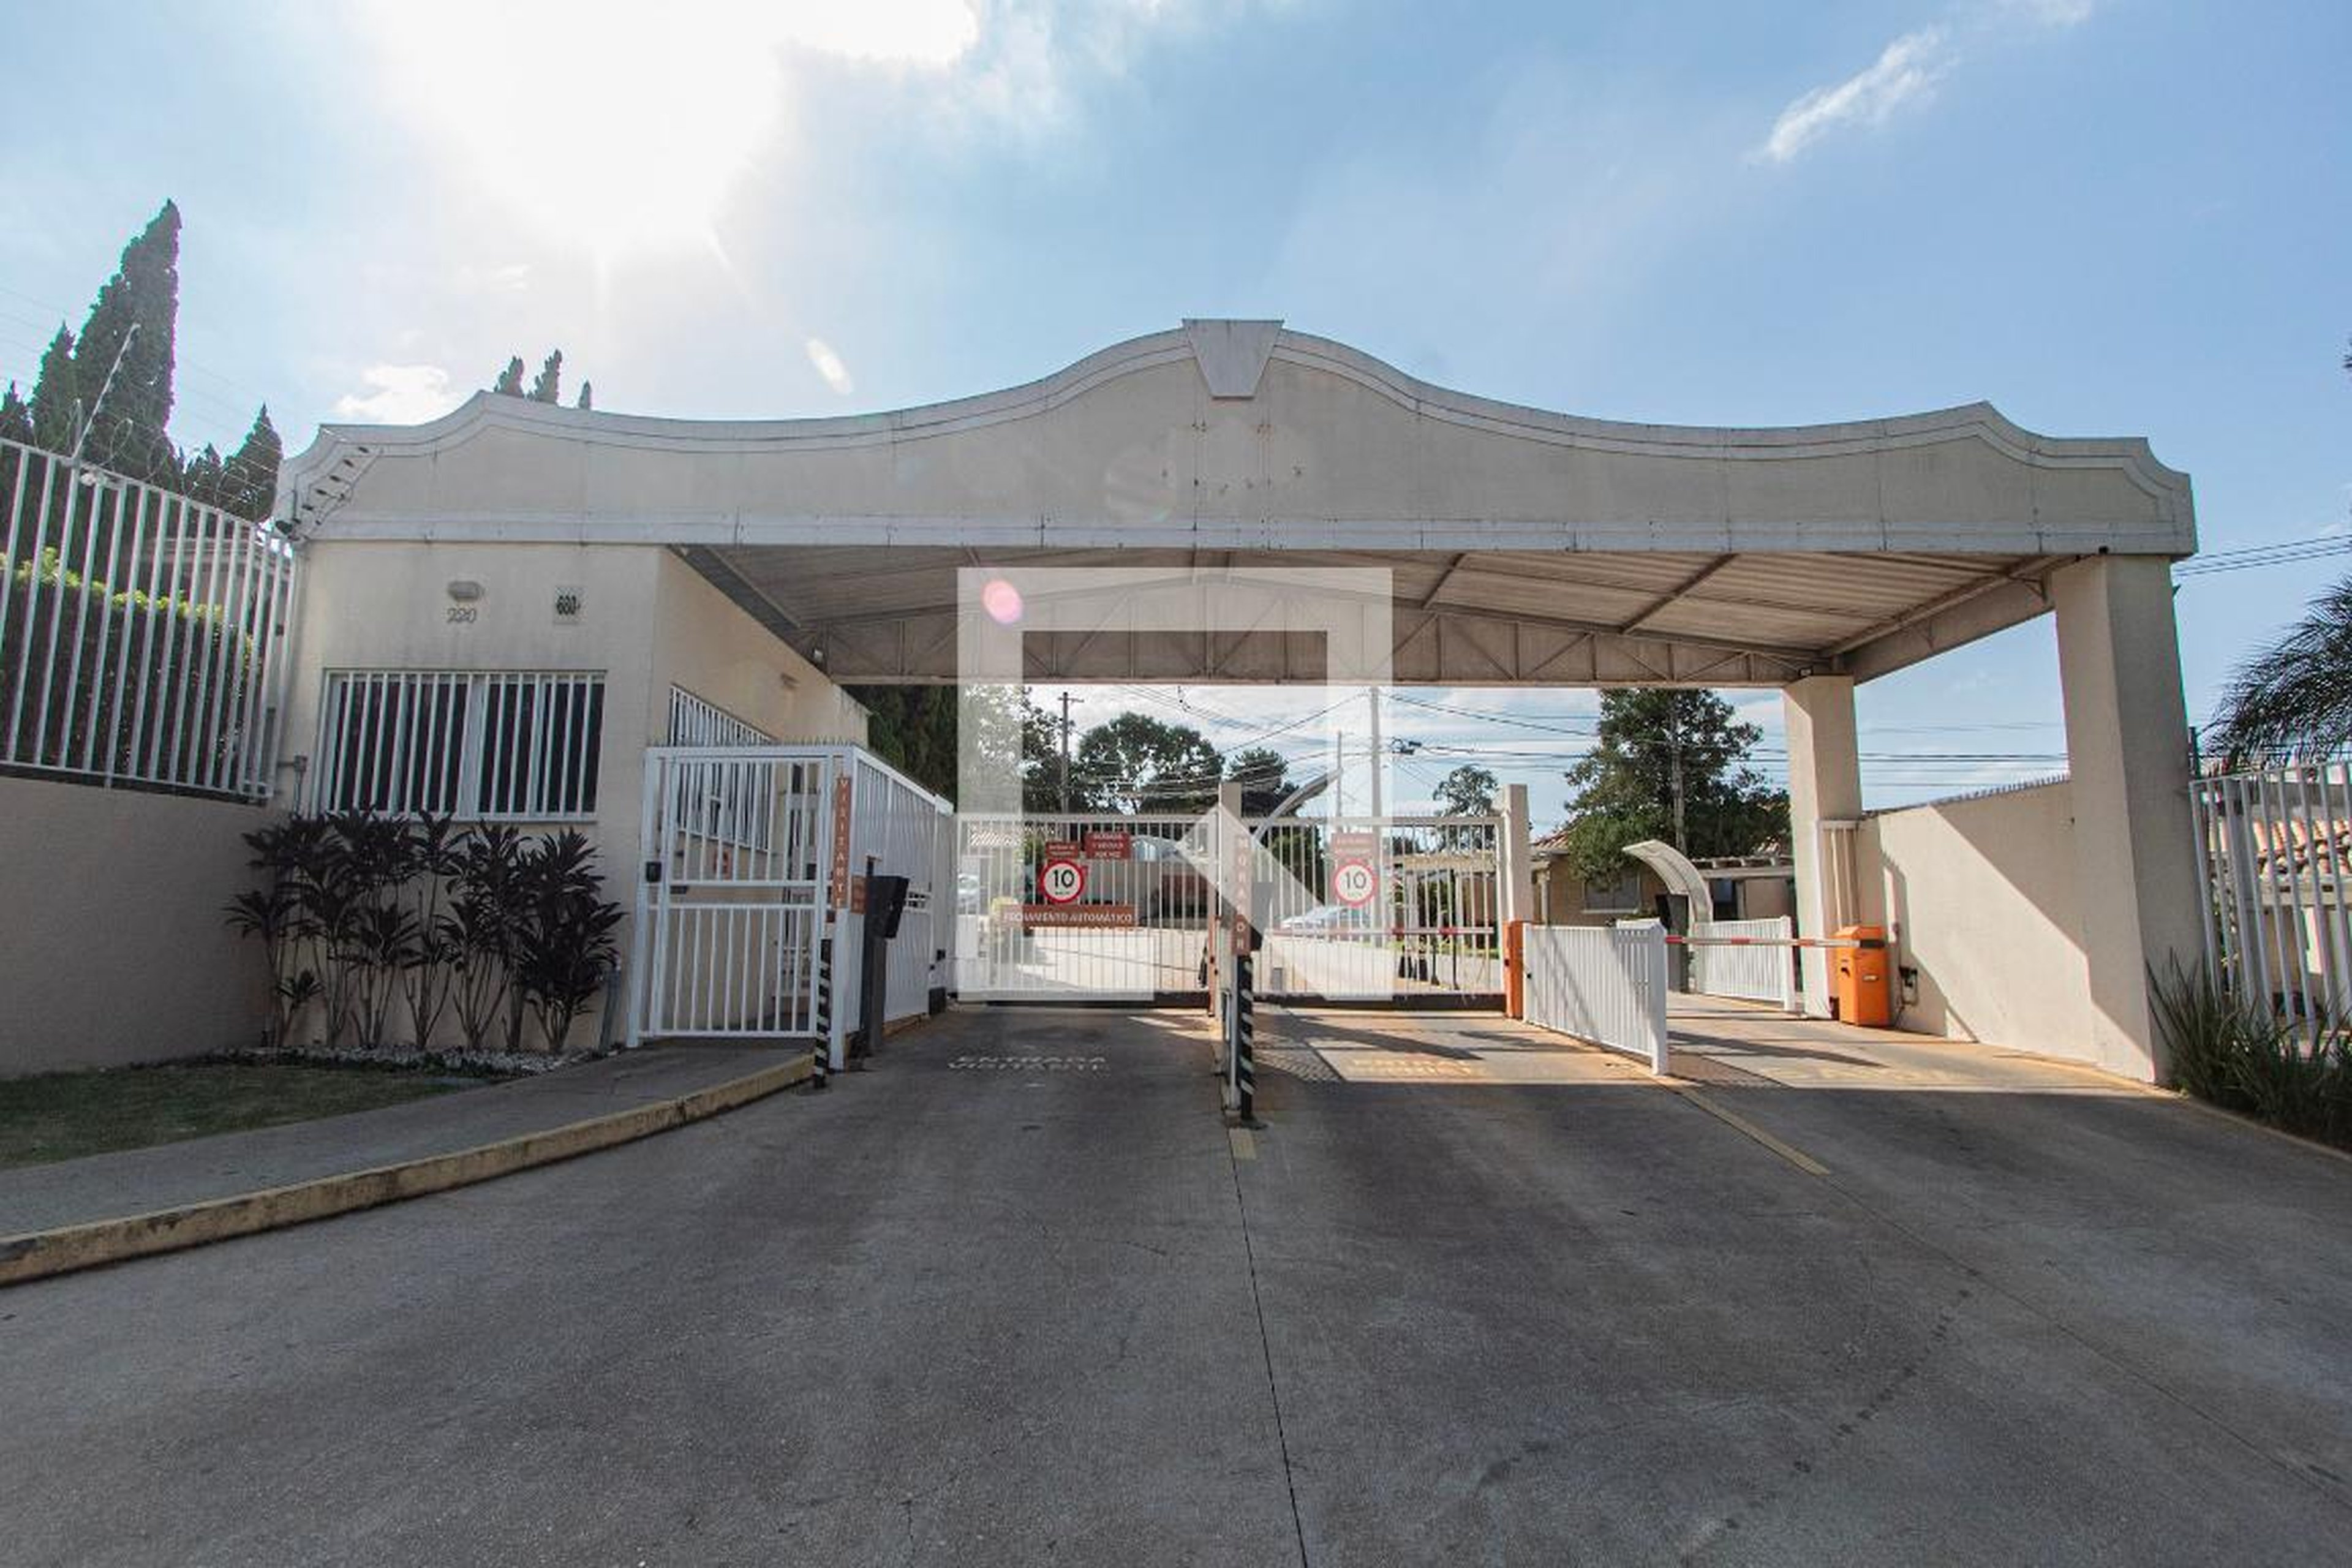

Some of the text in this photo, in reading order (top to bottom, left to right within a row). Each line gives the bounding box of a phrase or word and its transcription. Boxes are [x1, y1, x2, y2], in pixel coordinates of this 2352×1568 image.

[447, 608, 477, 624] 220
[835, 778, 849, 907] VISITANTE
[1054, 869, 1074, 888] 10
[1346, 871, 1367, 890] 10
[1236, 837, 1249, 949] MORADOR
